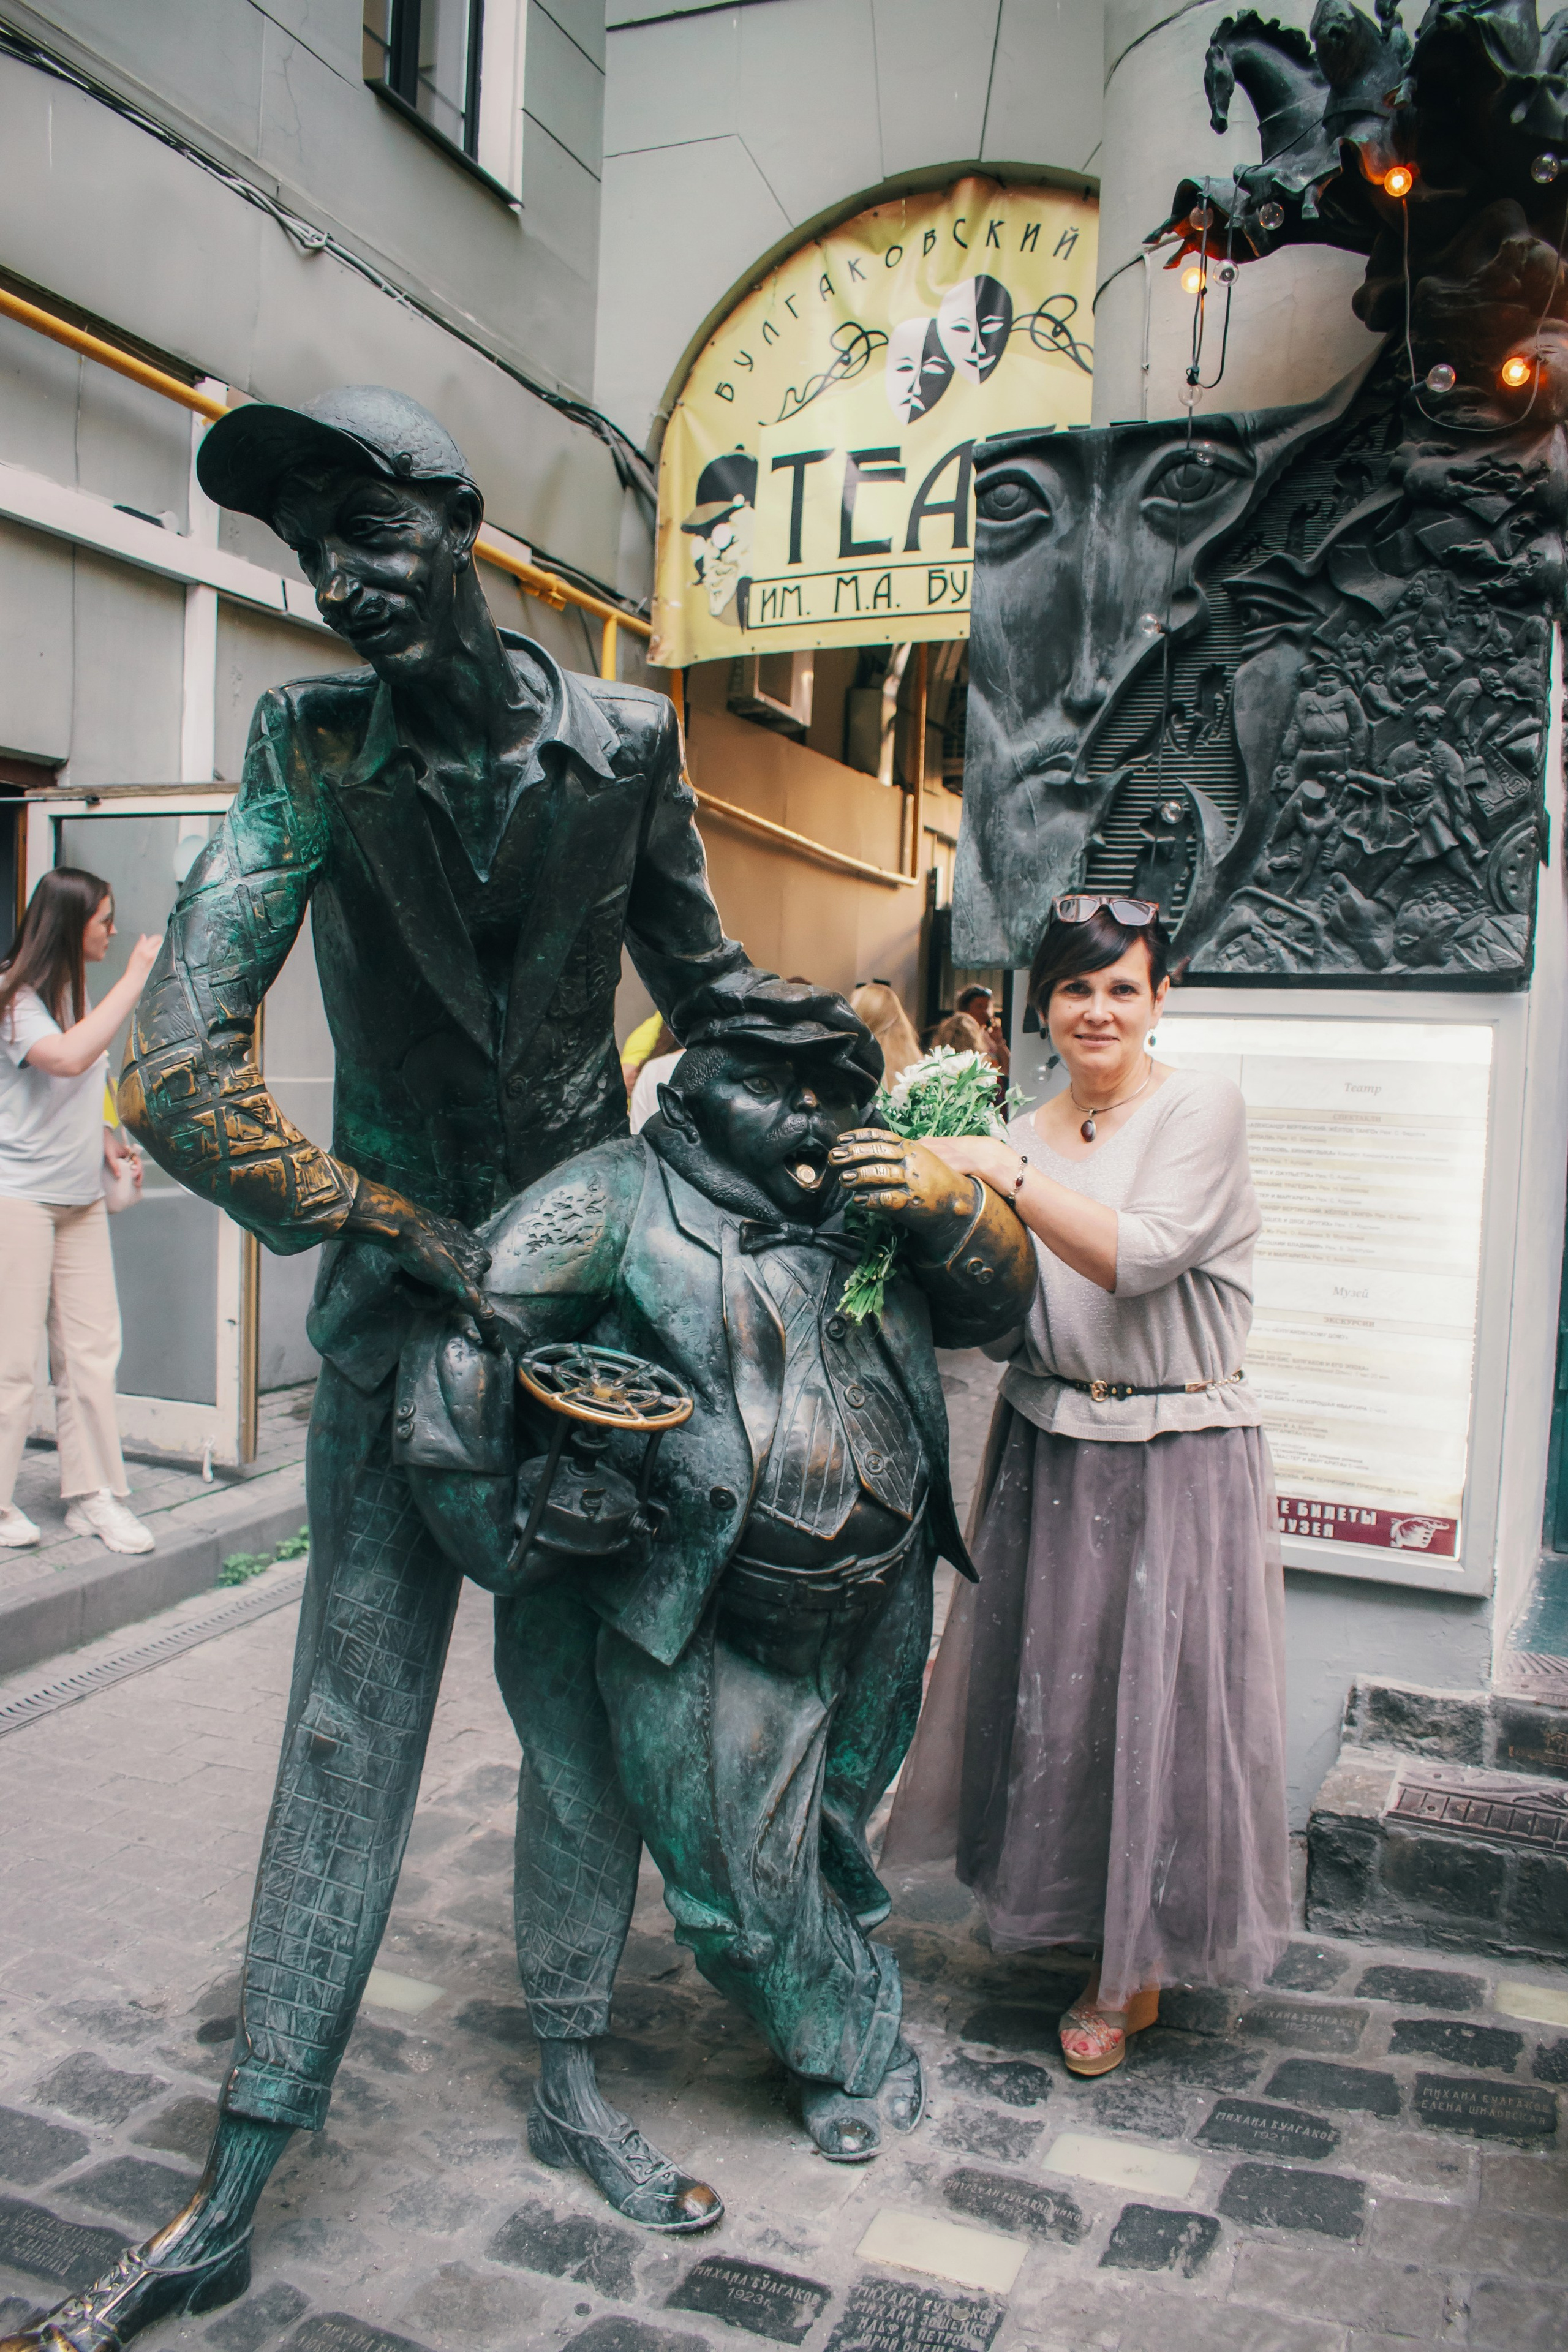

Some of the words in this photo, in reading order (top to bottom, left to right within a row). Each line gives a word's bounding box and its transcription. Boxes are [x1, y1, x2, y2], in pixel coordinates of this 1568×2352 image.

[715, 217, 1080, 403] БУЛГАКОВСКИЙ
[771, 423, 1069, 565] ТЕА
[761, 585, 810, 622] ИМ.
[834, 573, 902, 613] М.А.
[1344, 1082, 1382, 1096] Театр
[1333, 1114, 1382, 1123] СПЕКТАКЛИ
[1332, 1286, 1370, 1299] Музей
[1323, 1316, 1375, 1328] ЭКСКУРСИИ
[1297, 1501, 1378, 1526] БИЛЕТЫ
[1421, 2099, 1462, 2113] ЕЛЕНА
[1422, 2087, 1476, 2102] МИХАИЛ
[1215, 2111, 1267, 2128] МИХАИЛ
[1270, 2120, 1335, 2142] БУЛГАКОВ
[692, 2265, 747, 2286] МИХАИЛ
[750, 2275, 821, 2305] БУЛГАКОВ
[853, 2301, 915, 2324] МИХАИЛ
[857, 2286, 918, 2309] МИХАИЛ
[922, 2299, 998, 2325] БУЛГКОВ
[858, 2316, 900, 2334] ИЛЬФ
[902, 2326, 914, 2339] И
[859, 2332, 900, 2351] ЮРИЙ
